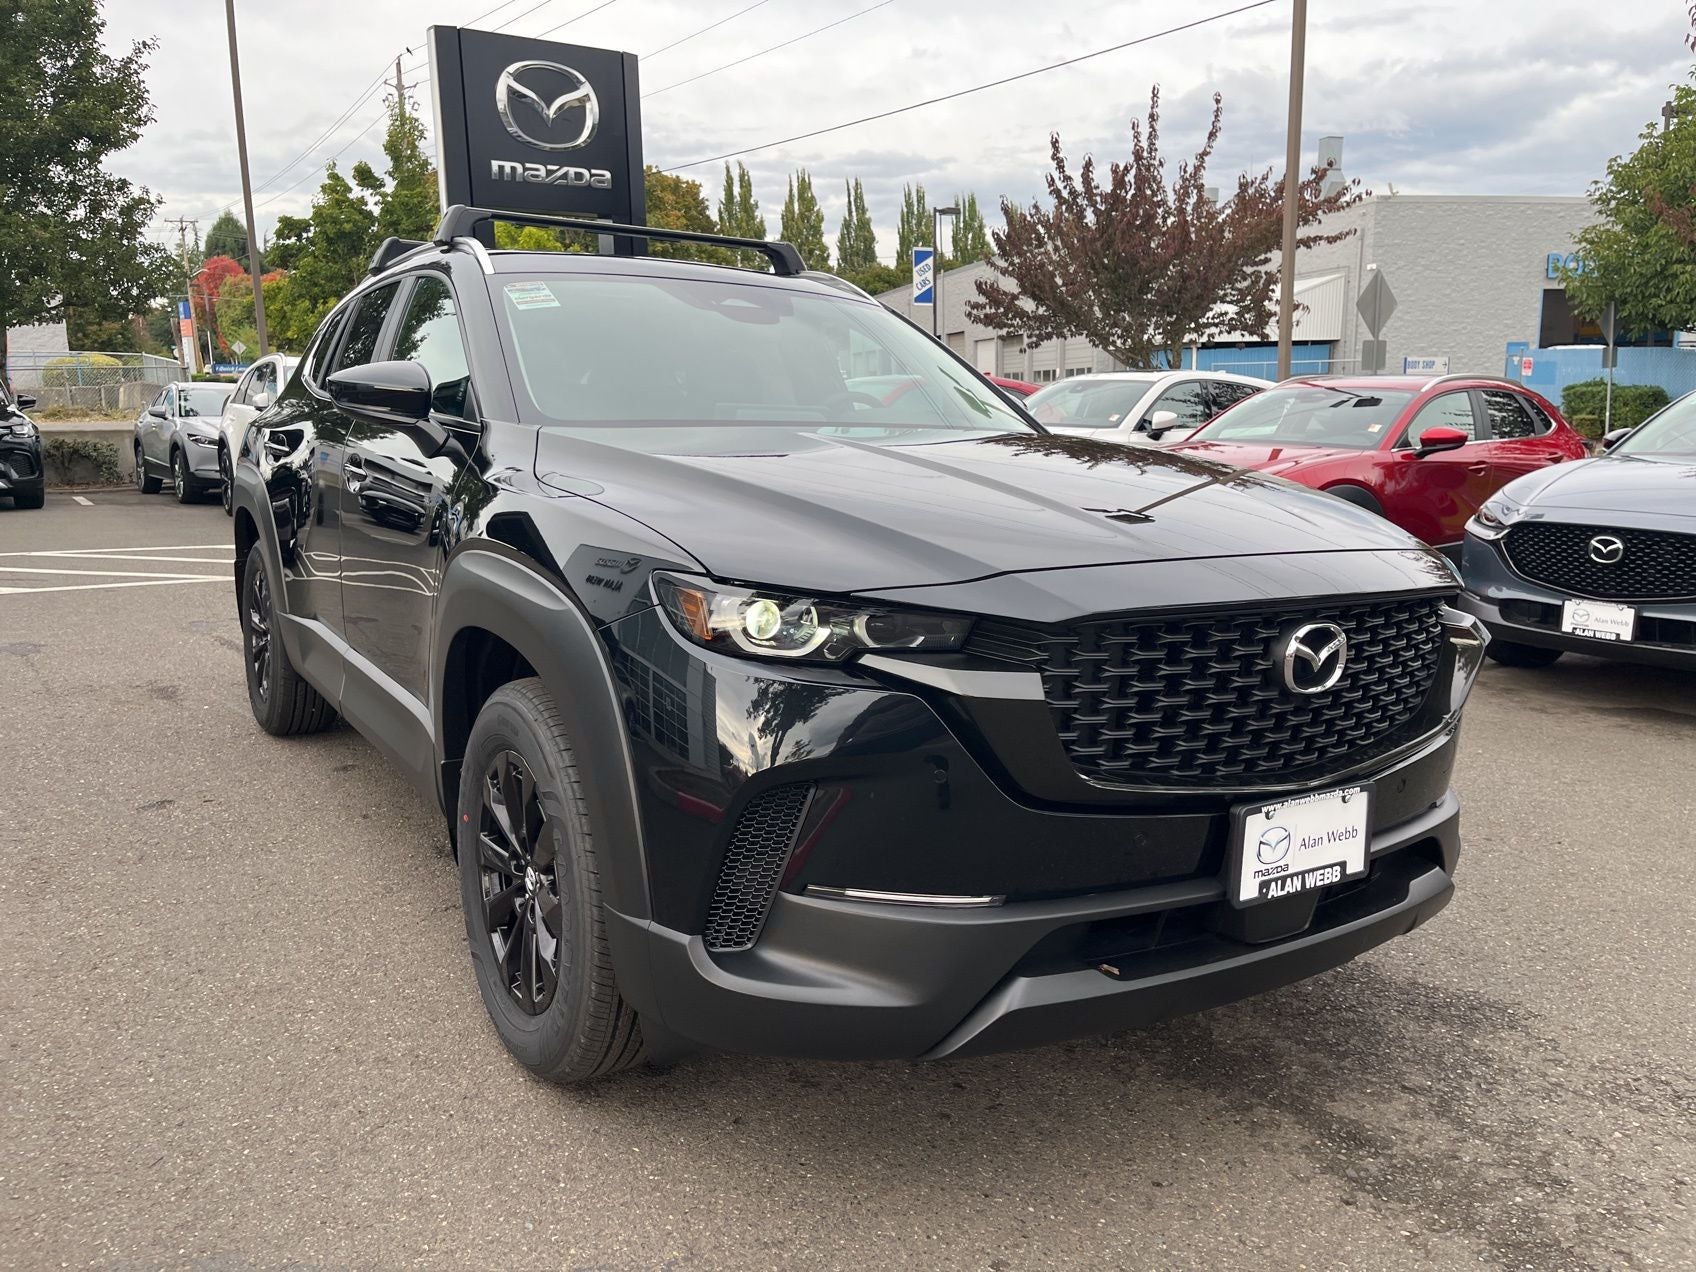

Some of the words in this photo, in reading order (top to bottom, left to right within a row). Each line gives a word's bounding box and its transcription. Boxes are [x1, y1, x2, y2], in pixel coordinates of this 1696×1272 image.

[915, 263, 932, 277] USED
[915, 277, 931, 291] CARS
[1408, 360, 1421, 370] BODY
[1422, 360, 1436, 370] SHOP
[1610, 617, 1630, 627] Webb
[1575, 628, 1594, 637] ALAN
[1595, 631, 1616, 640] WEBB
[1261, 787, 1360, 813] www.alanwebbmazda.com
[1298, 836, 1323, 851] Alan
[1327, 826, 1358, 845] Webb
[1268, 875, 1302, 899] ALAN
[1304, 866, 1341, 889] WEBB
